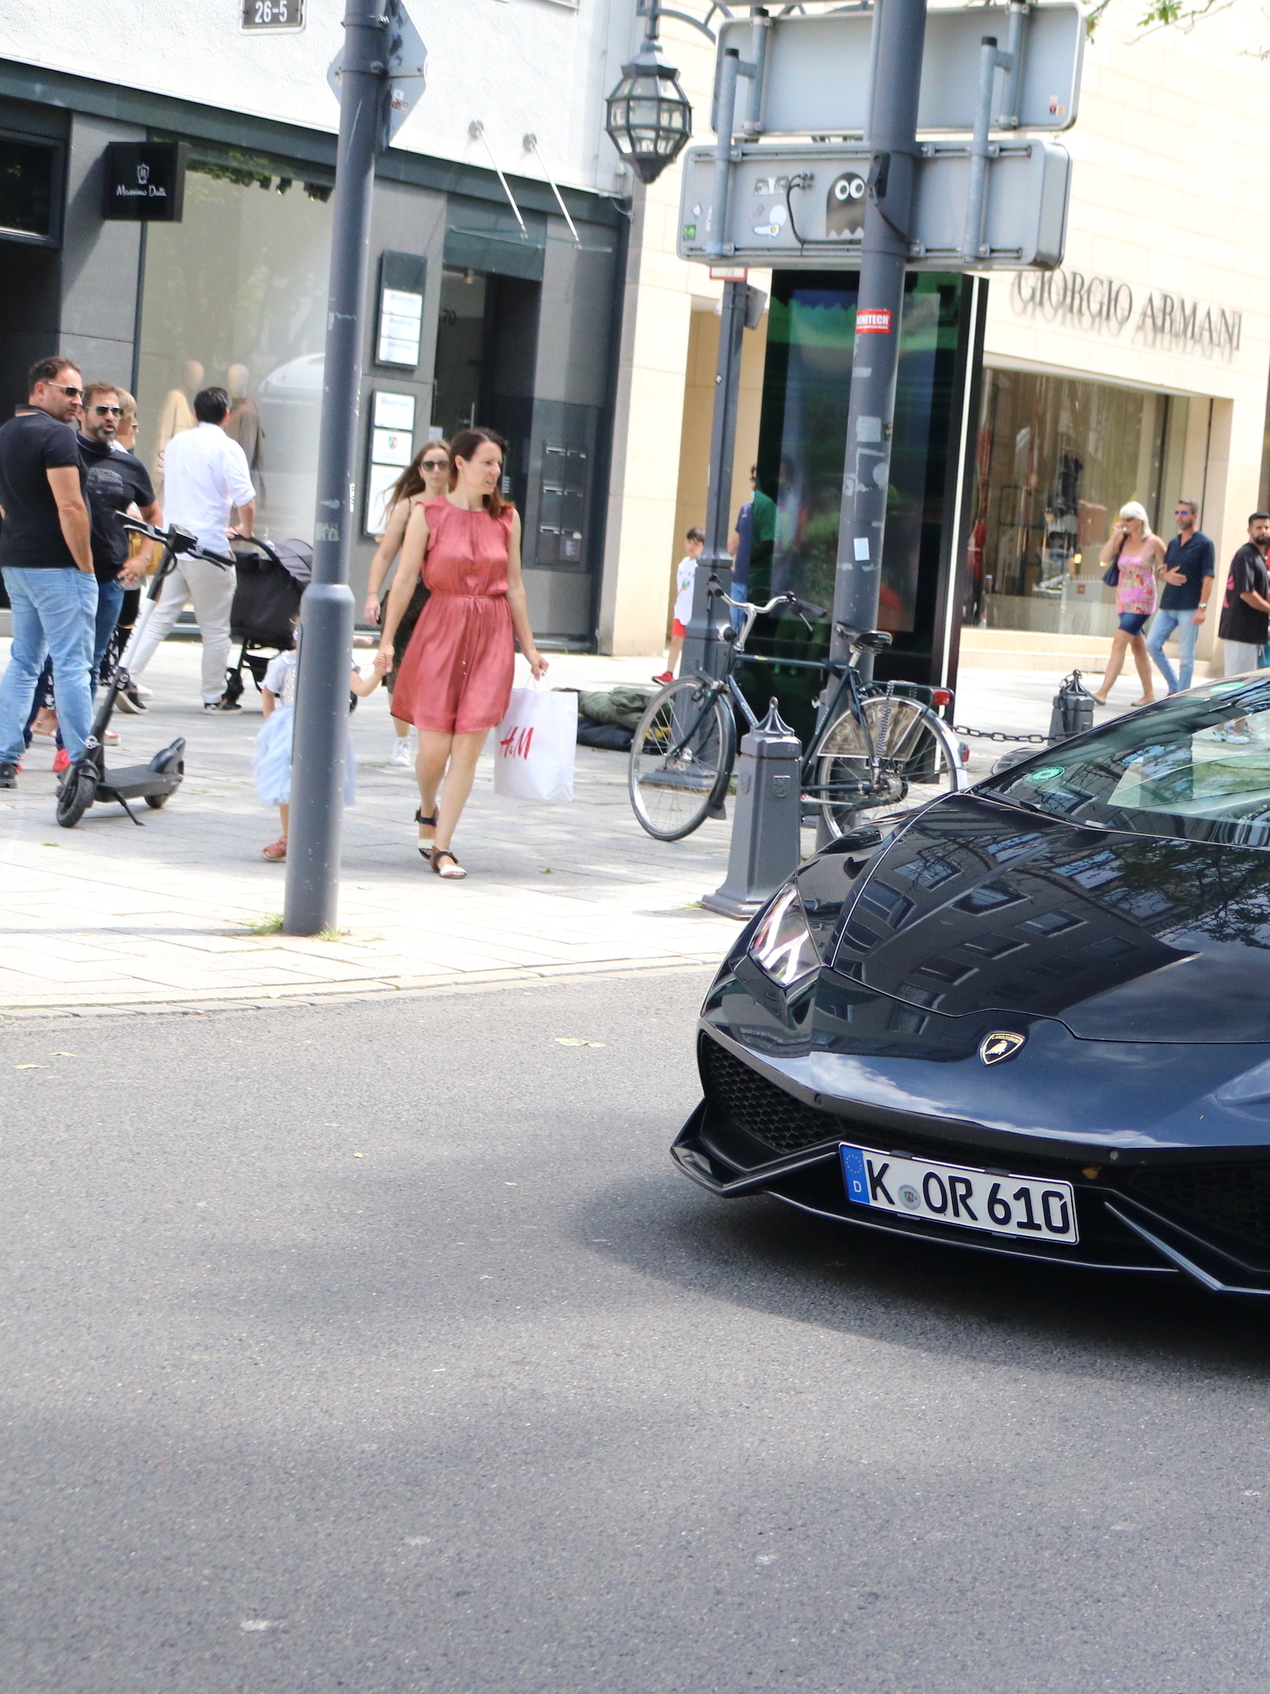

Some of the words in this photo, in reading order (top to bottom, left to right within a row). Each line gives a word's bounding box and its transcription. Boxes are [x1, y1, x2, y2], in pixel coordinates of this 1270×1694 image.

[254, 0, 288, 24] 26-5
[116, 184, 147, 196] Massimo
[148, 185, 167, 197] Dutti
[1017, 267, 1133, 326] GIORGIO
[1138, 291, 1243, 351] ARMANI
[500, 726, 534, 761] H&M
[853, 1180, 862, 1193] D
[866, 1159, 895, 1206] K
[922, 1171, 978, 1221] OR
[987, 1182, 1070, 1235] 610
